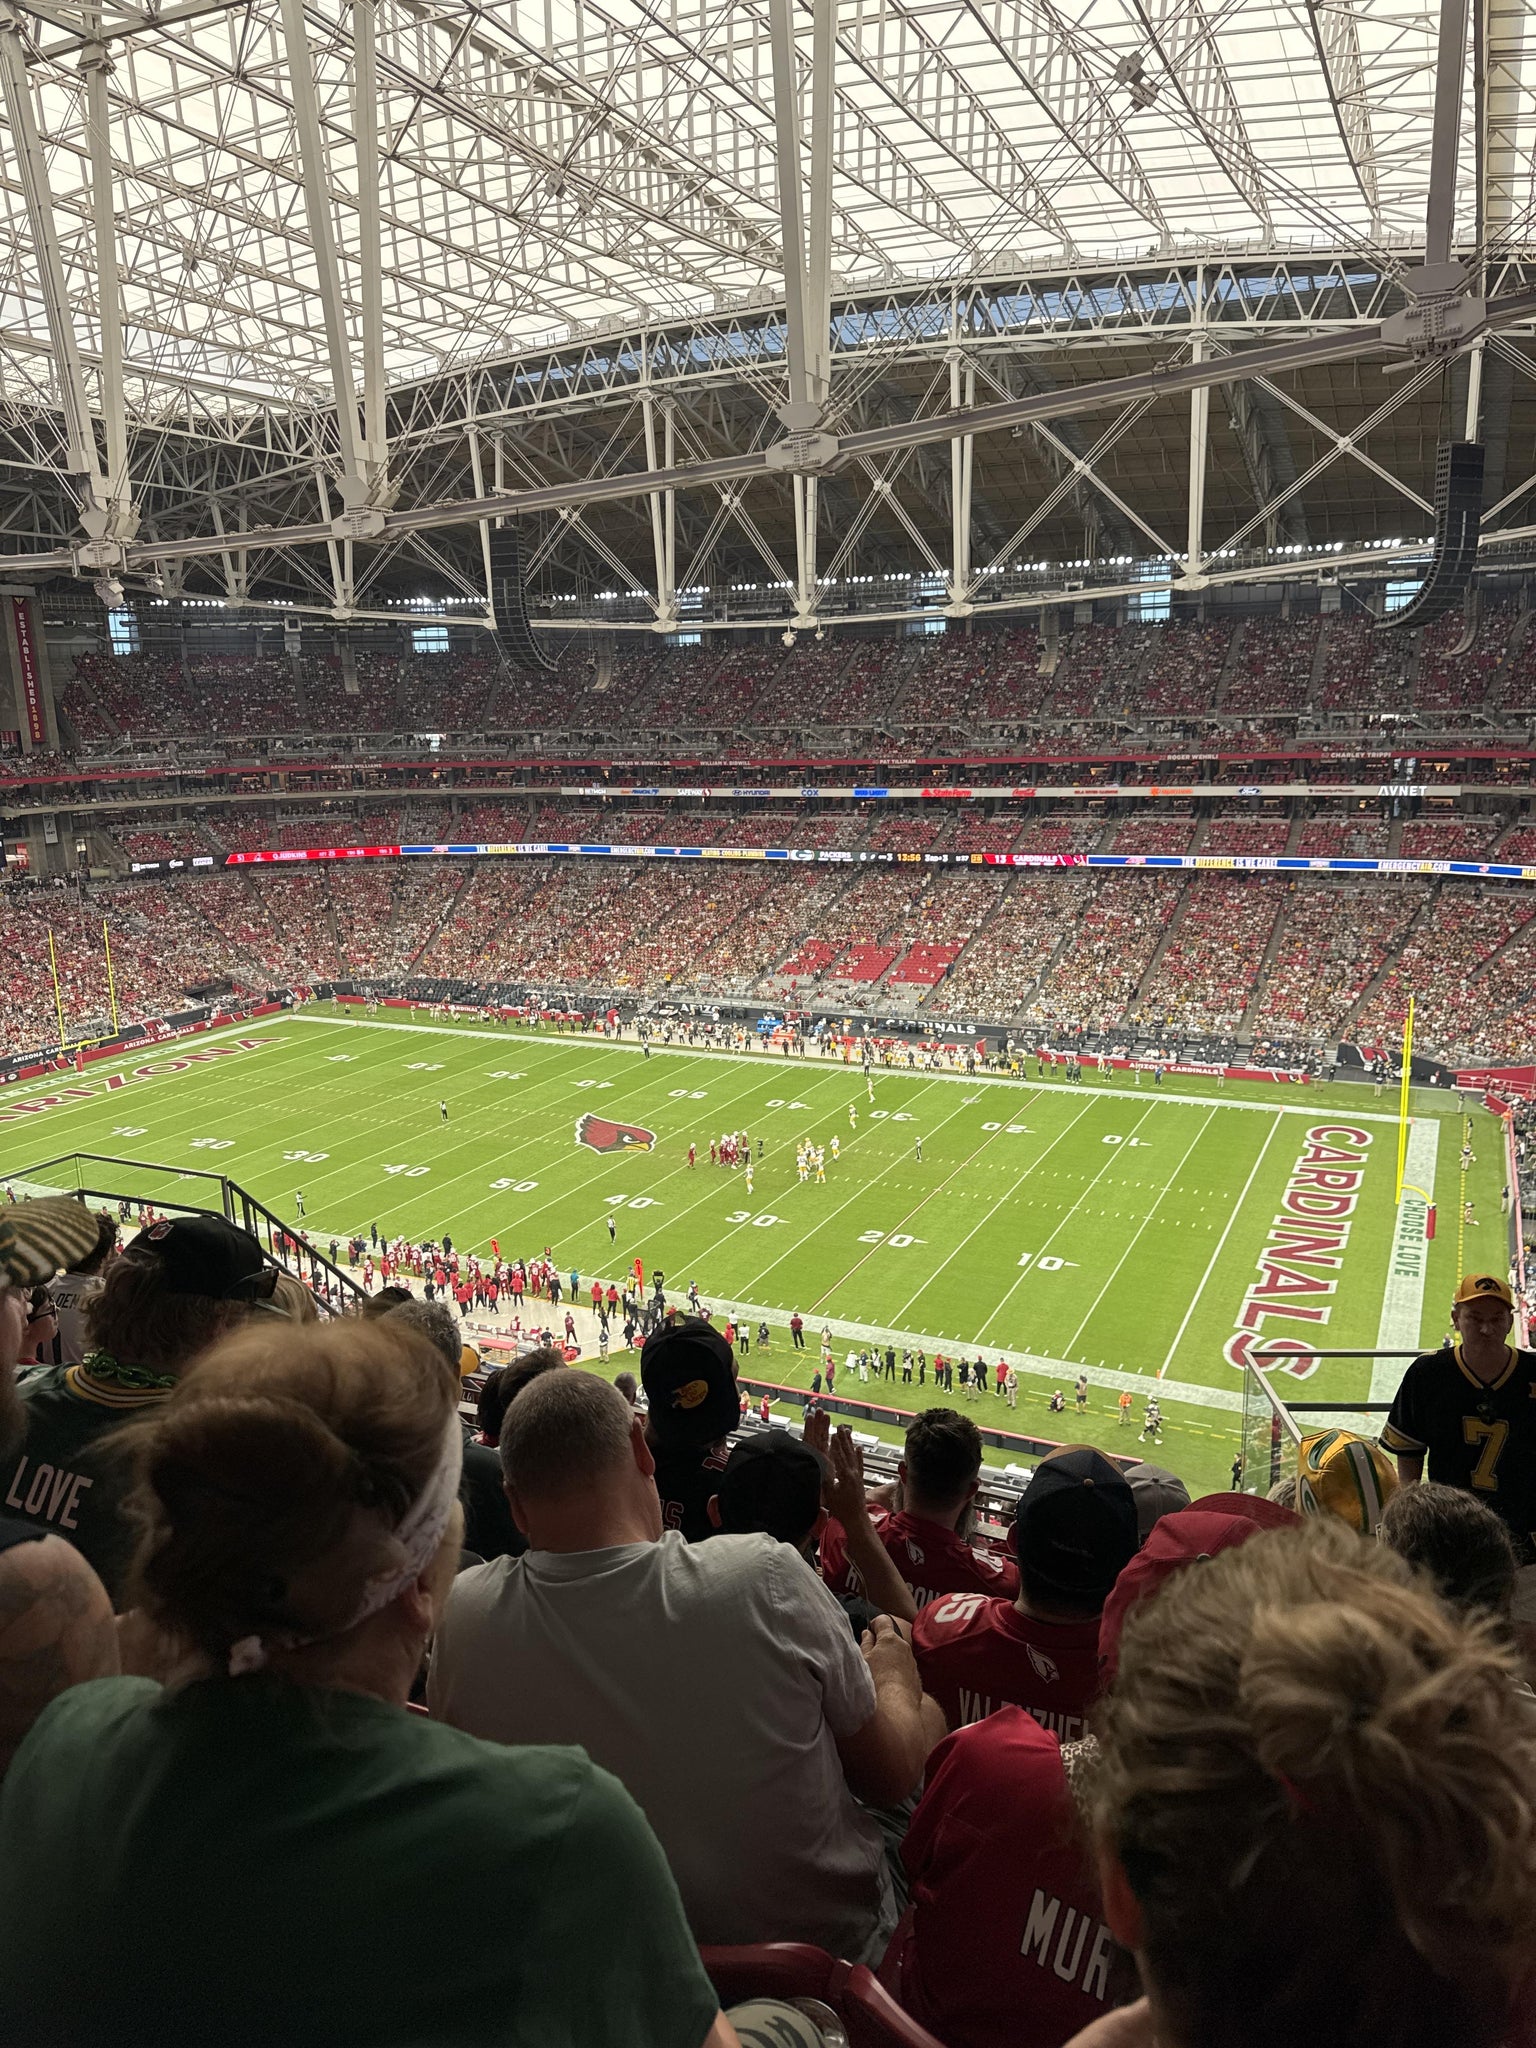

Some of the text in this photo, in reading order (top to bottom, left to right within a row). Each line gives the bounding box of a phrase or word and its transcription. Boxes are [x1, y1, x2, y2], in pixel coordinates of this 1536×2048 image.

[18, 612, 41, 739] ESTABLISHED 1898
[677, 788, 703, 796] SAFEWAY
[1378, 785, 1428, 796] AVNET
[860, 852, 866, 860] 6
[897, 854, 921, 862] 13:56
[995, 855, 1006, 864] 13
[1196, 858, 1234, 868] DIFFERENCE
[1378, 862, 1450, 872] EMERGENCYAIR.COM
[123, 1037, 156, 1050] ARIZONA
[12, 1051, 43, 1064] ARIZONA
[1170, 1065, 1219, 1075] CARDINALS
[110, 1126, 148, 1137] 10
[188, 1137, 236, 1150] 20
[283, 1150, 330, 1163] 30
[383, 1164, 431, 1177] 40
[488, 1177, 539, 1192] 50
[602, 1194, 654, 1209] 40
[725, 1210, 778, 1227] 30
[856, 1229, 915, 1247] 20
[1394, 1199, 1427, 1277] CHOOSE LOVE
[1223, 1124, 1374, 1381] CARDINALS
[1016, 1252, 1065, 1271] 10
[1462, 1416, 1509, 1492] 7
[5, 1455, 94, 1530] LOVE
